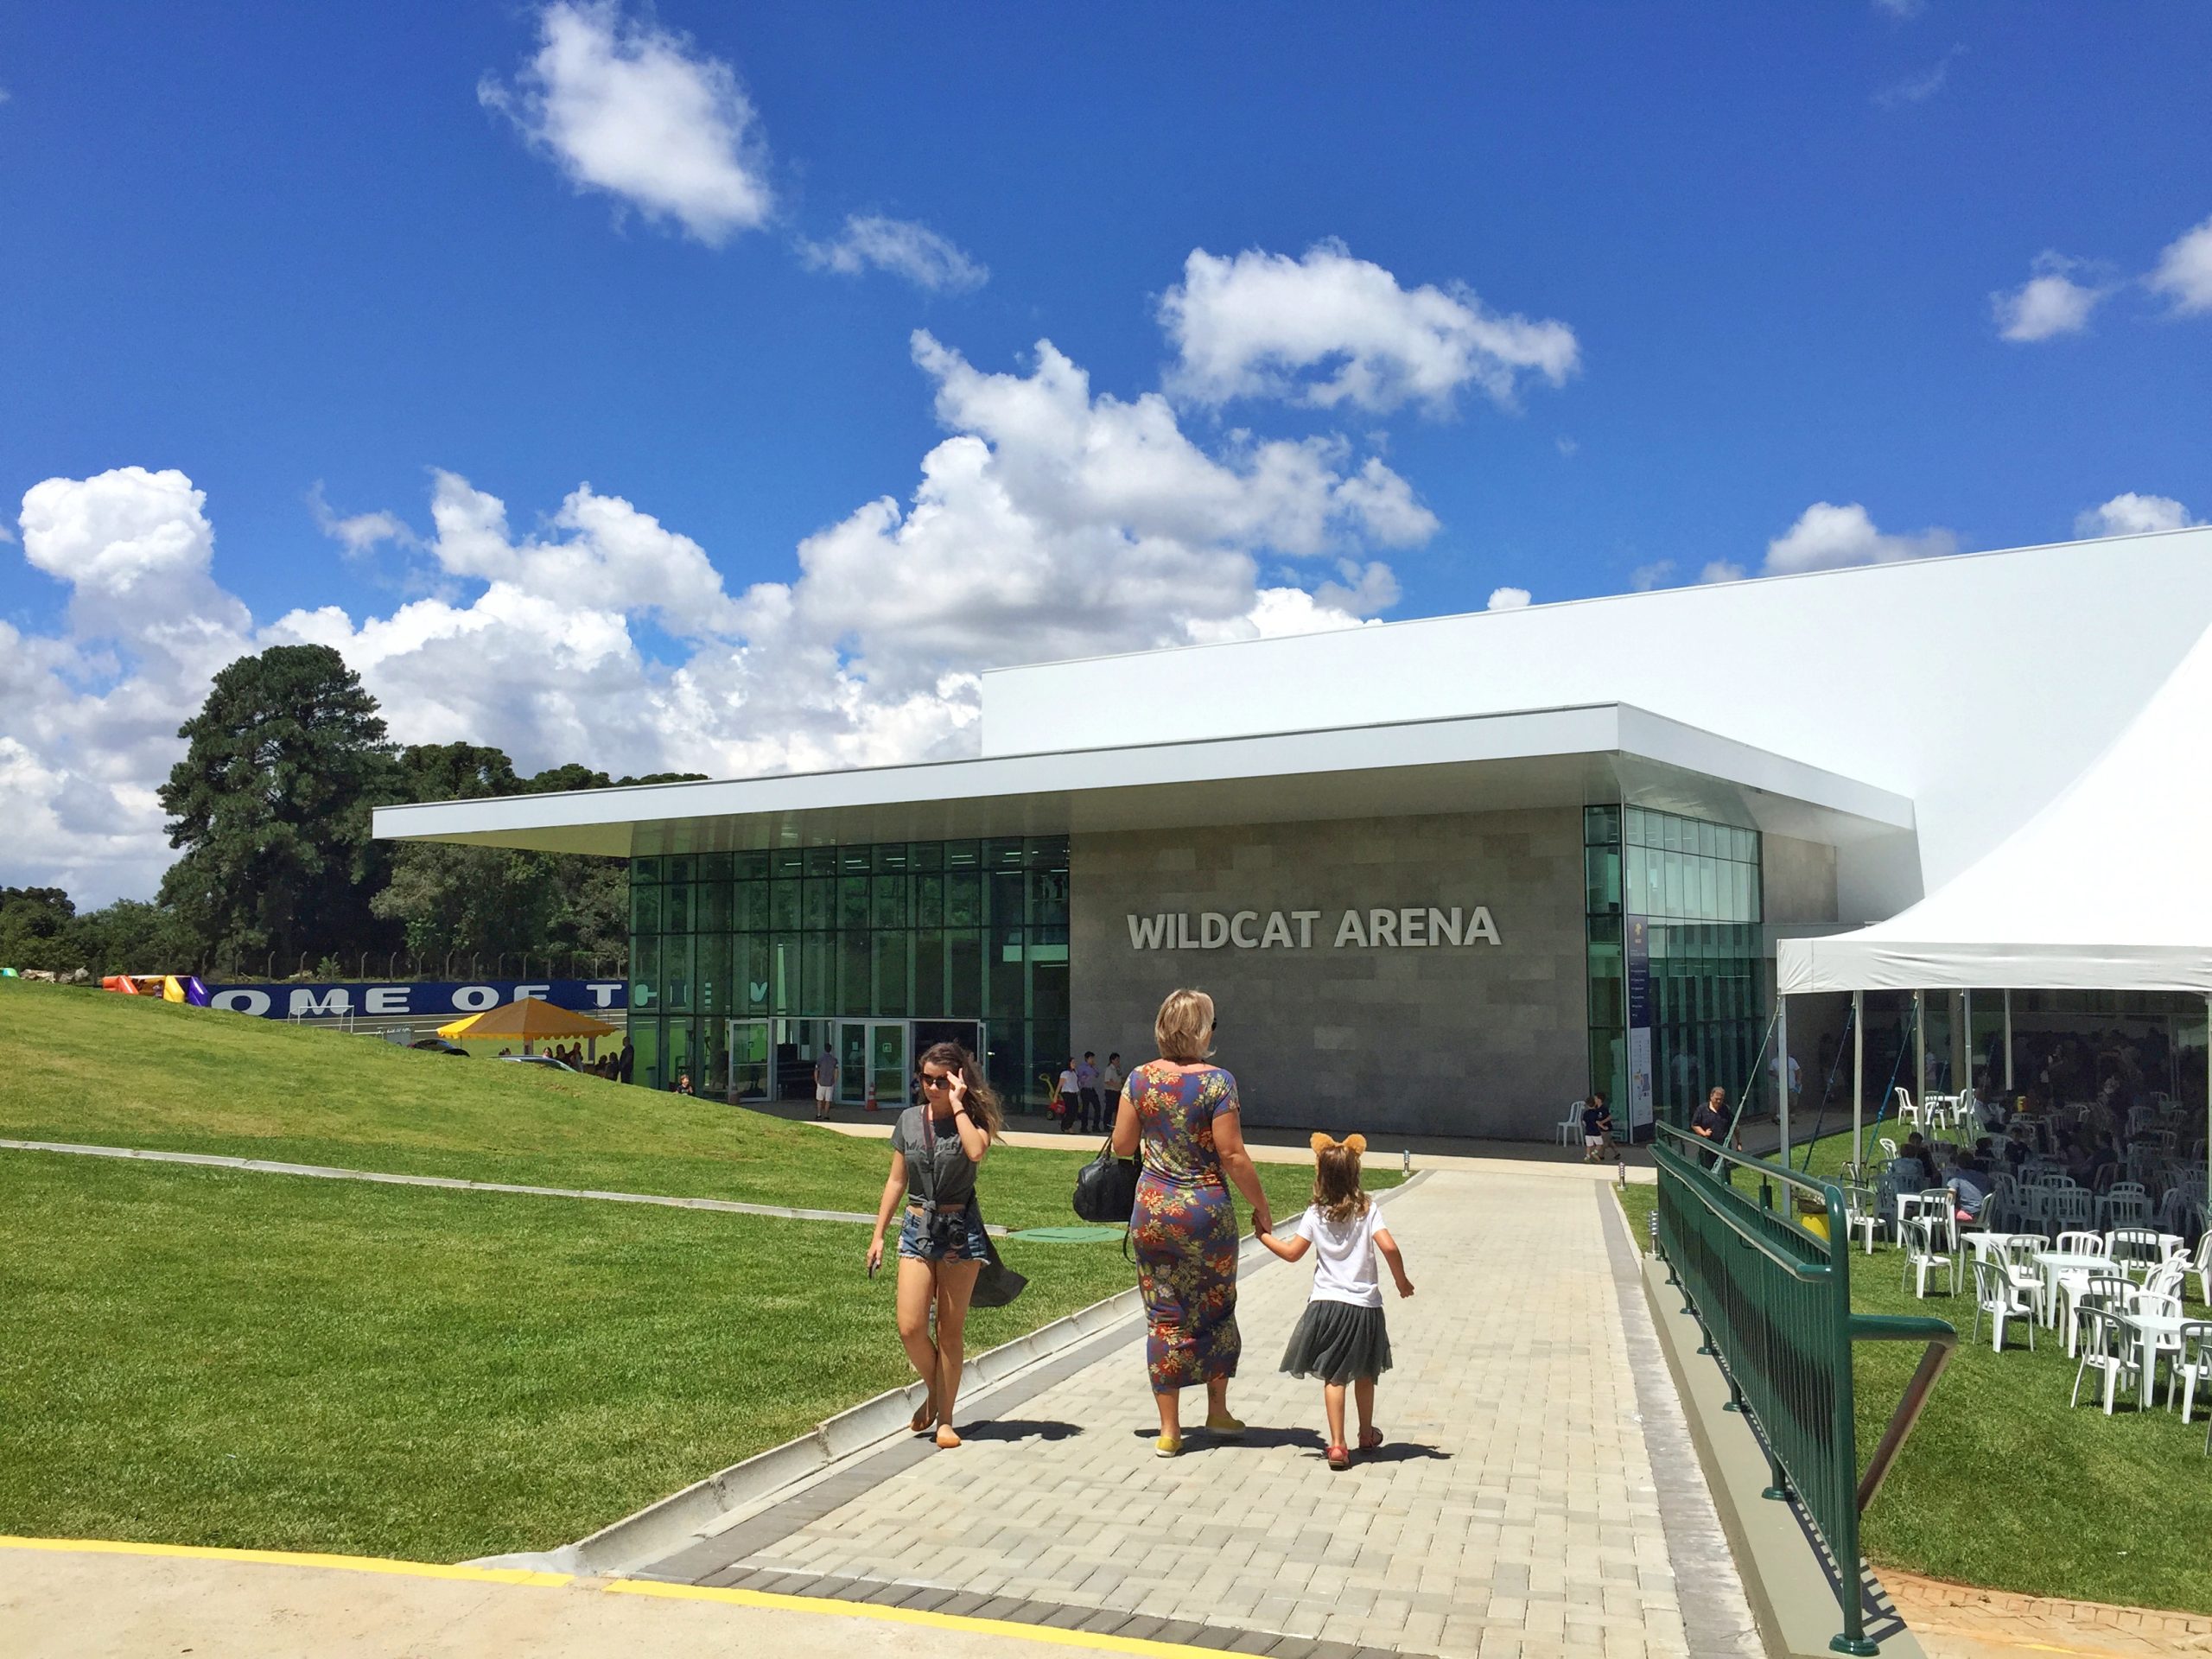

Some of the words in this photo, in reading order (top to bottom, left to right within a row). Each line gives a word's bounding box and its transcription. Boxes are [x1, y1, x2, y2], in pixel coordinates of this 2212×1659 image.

[1127, 911, 1320, 950] WILDCAT
[1334, 906, 1502, 947] ARENA
[451, 984, 550, 1011] OF
